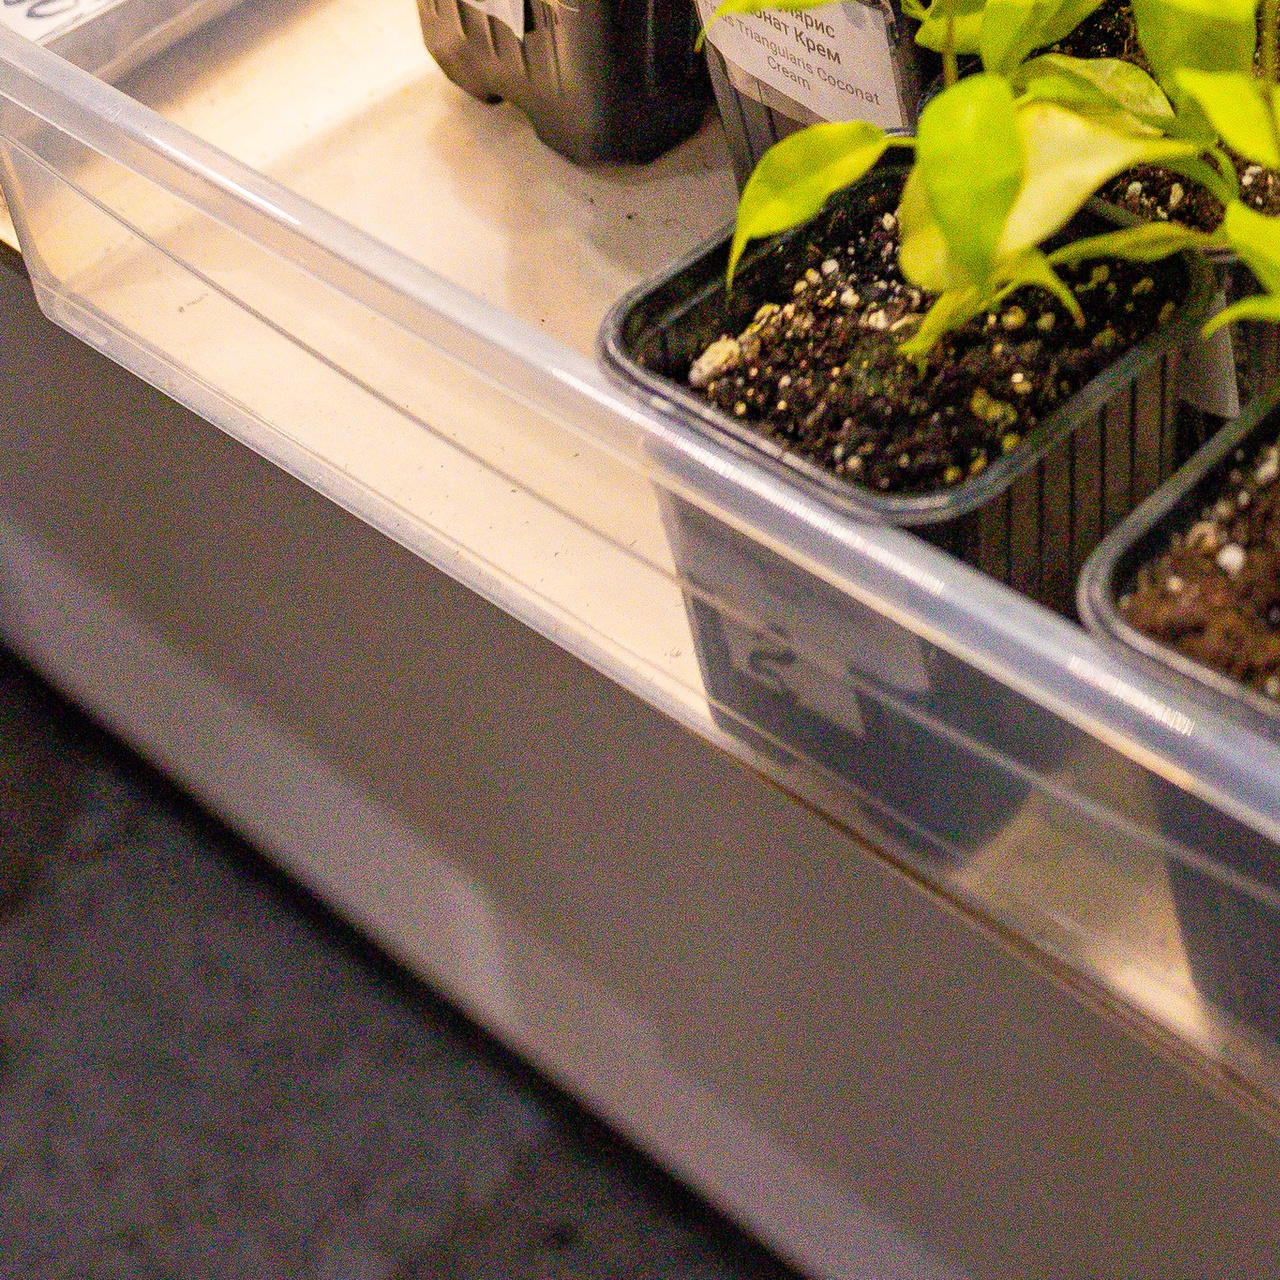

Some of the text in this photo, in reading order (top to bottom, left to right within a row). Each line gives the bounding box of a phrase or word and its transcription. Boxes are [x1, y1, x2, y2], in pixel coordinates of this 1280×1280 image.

[737, 19, 814, 75] Triangularis
[817, 66, 881, 106] Coconat
[794, 27, 841, 65] Крем
[767, 55, 811, 91] Cream
